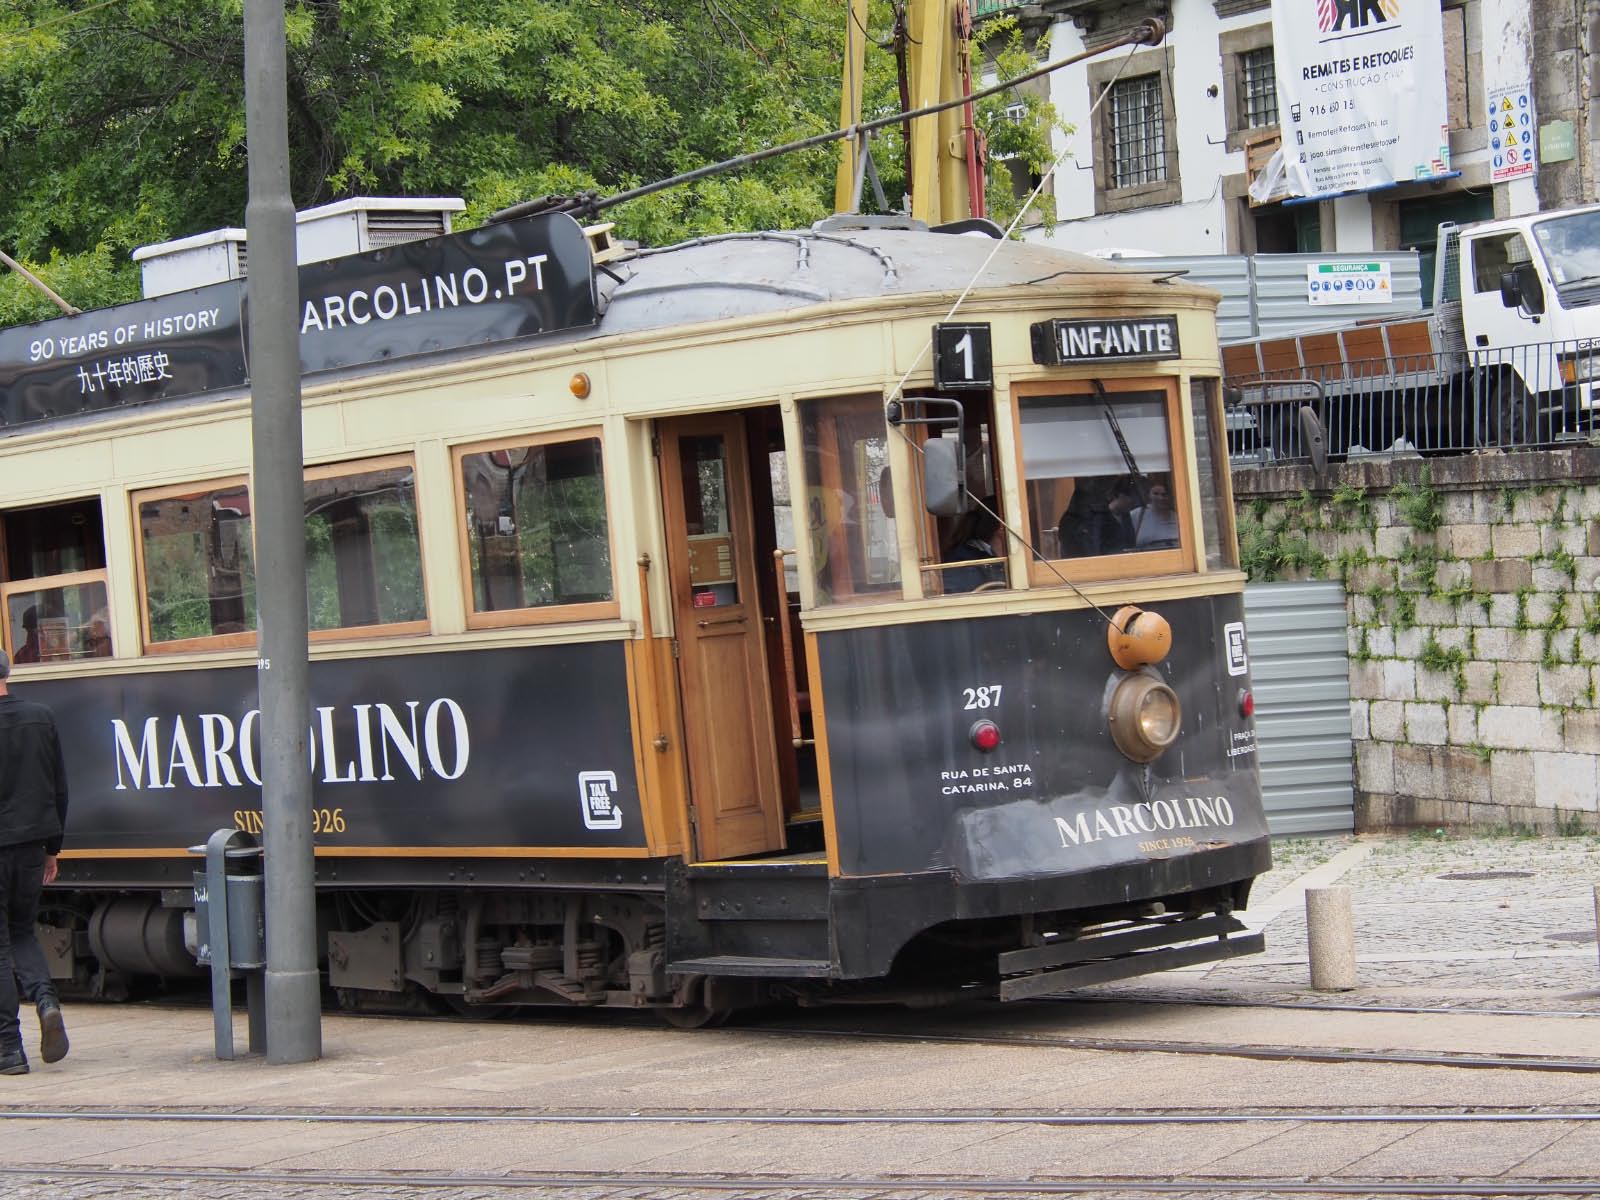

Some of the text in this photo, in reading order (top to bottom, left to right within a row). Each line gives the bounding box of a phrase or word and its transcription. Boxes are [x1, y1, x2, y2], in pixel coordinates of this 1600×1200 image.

[1353, 57, 1360, 70] E
[1362, 45, 1413, 69] RETOQUES
[1310, 105, 1326, 116] 916
[1332, 264, 1368, 272] SEGURANÇA
[301, 254, 548, 334] ARCOLINO.PT
[30, 308, 219, 361] 90 YEARS OF HISTORY
[1061, 324, 1172, 356] INFANTE
[955, 331, 973, 379] 1
[963, 685, 1002, 709] 287
[941, 764, 1032, 780] RUA DE SANTA
[589, 783, 608, 797] TAX
[942, 777, 1032, 795] CATARINA, 84
[589, 796, 611, 810] FREE
[1053, 796, 1234, 848] MARCOLINO
[1136, 836, 1194, 852] SINCE 1926
